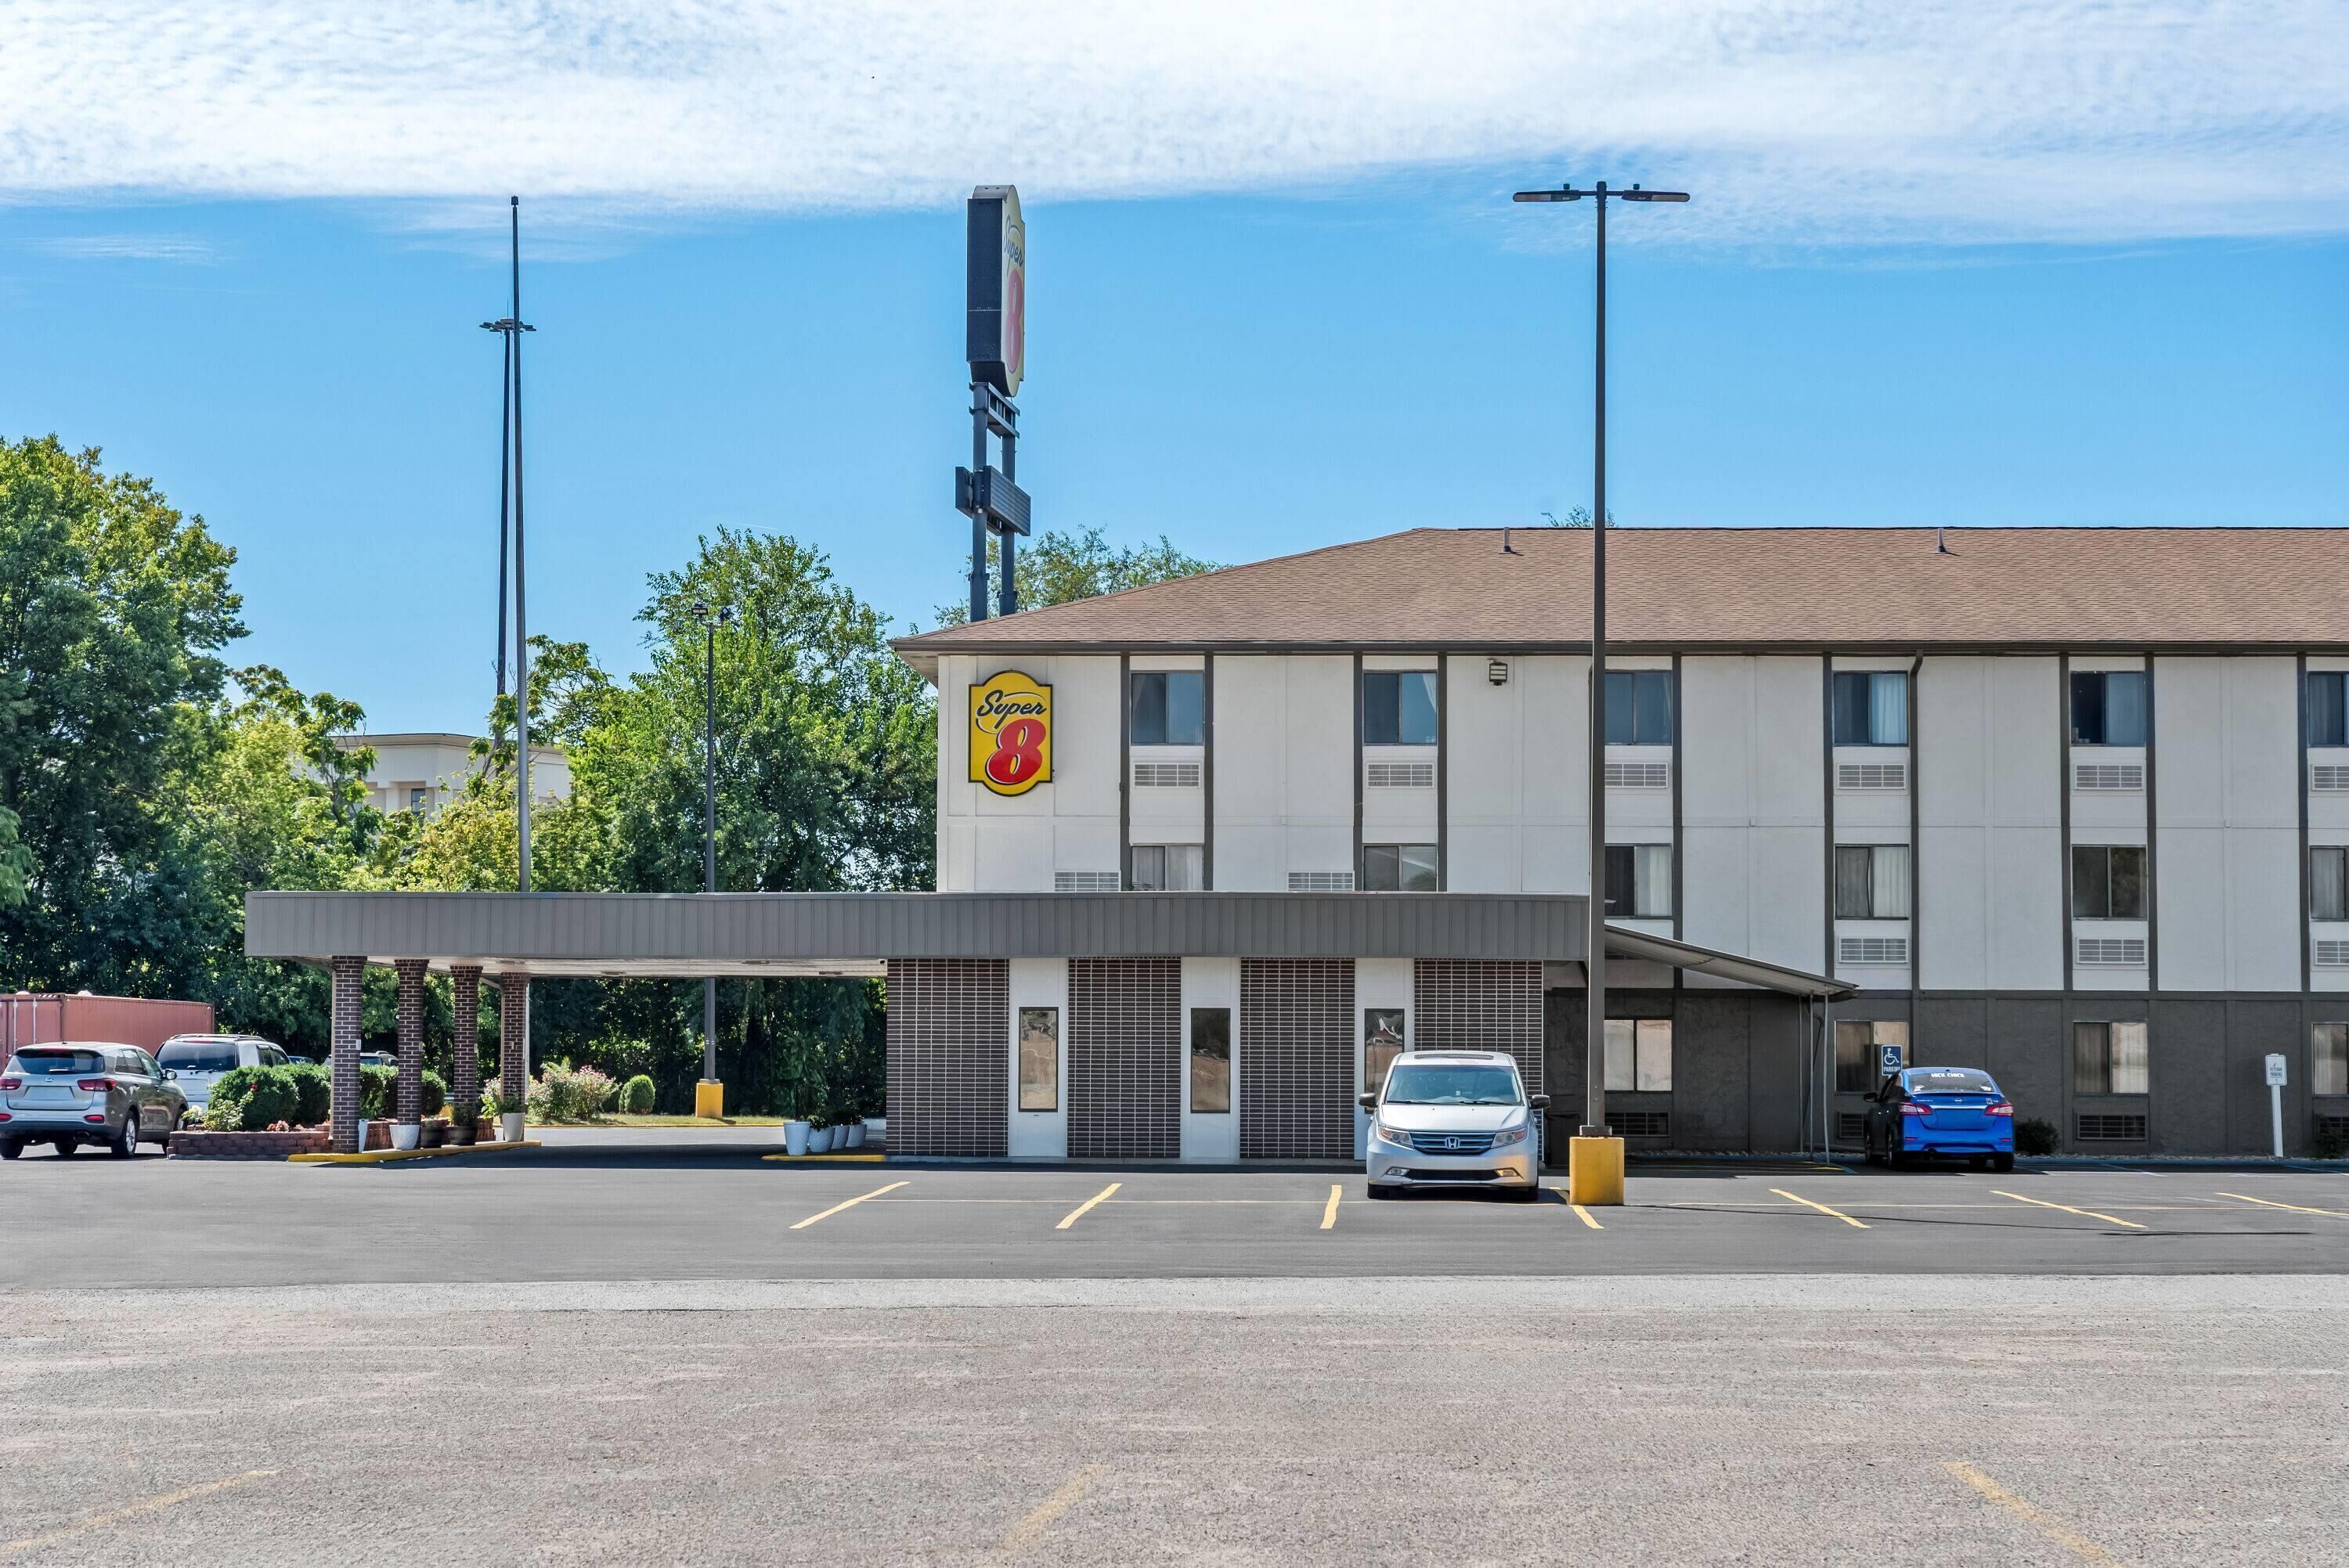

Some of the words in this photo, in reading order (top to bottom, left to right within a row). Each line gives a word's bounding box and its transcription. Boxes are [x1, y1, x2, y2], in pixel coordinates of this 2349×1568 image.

[1003, 214, 1024, 278] Super
[1005, 269, 1023, 373] 8
[976, 689, 1047, 731] Super
[985, 718, 1047, 785] 8
